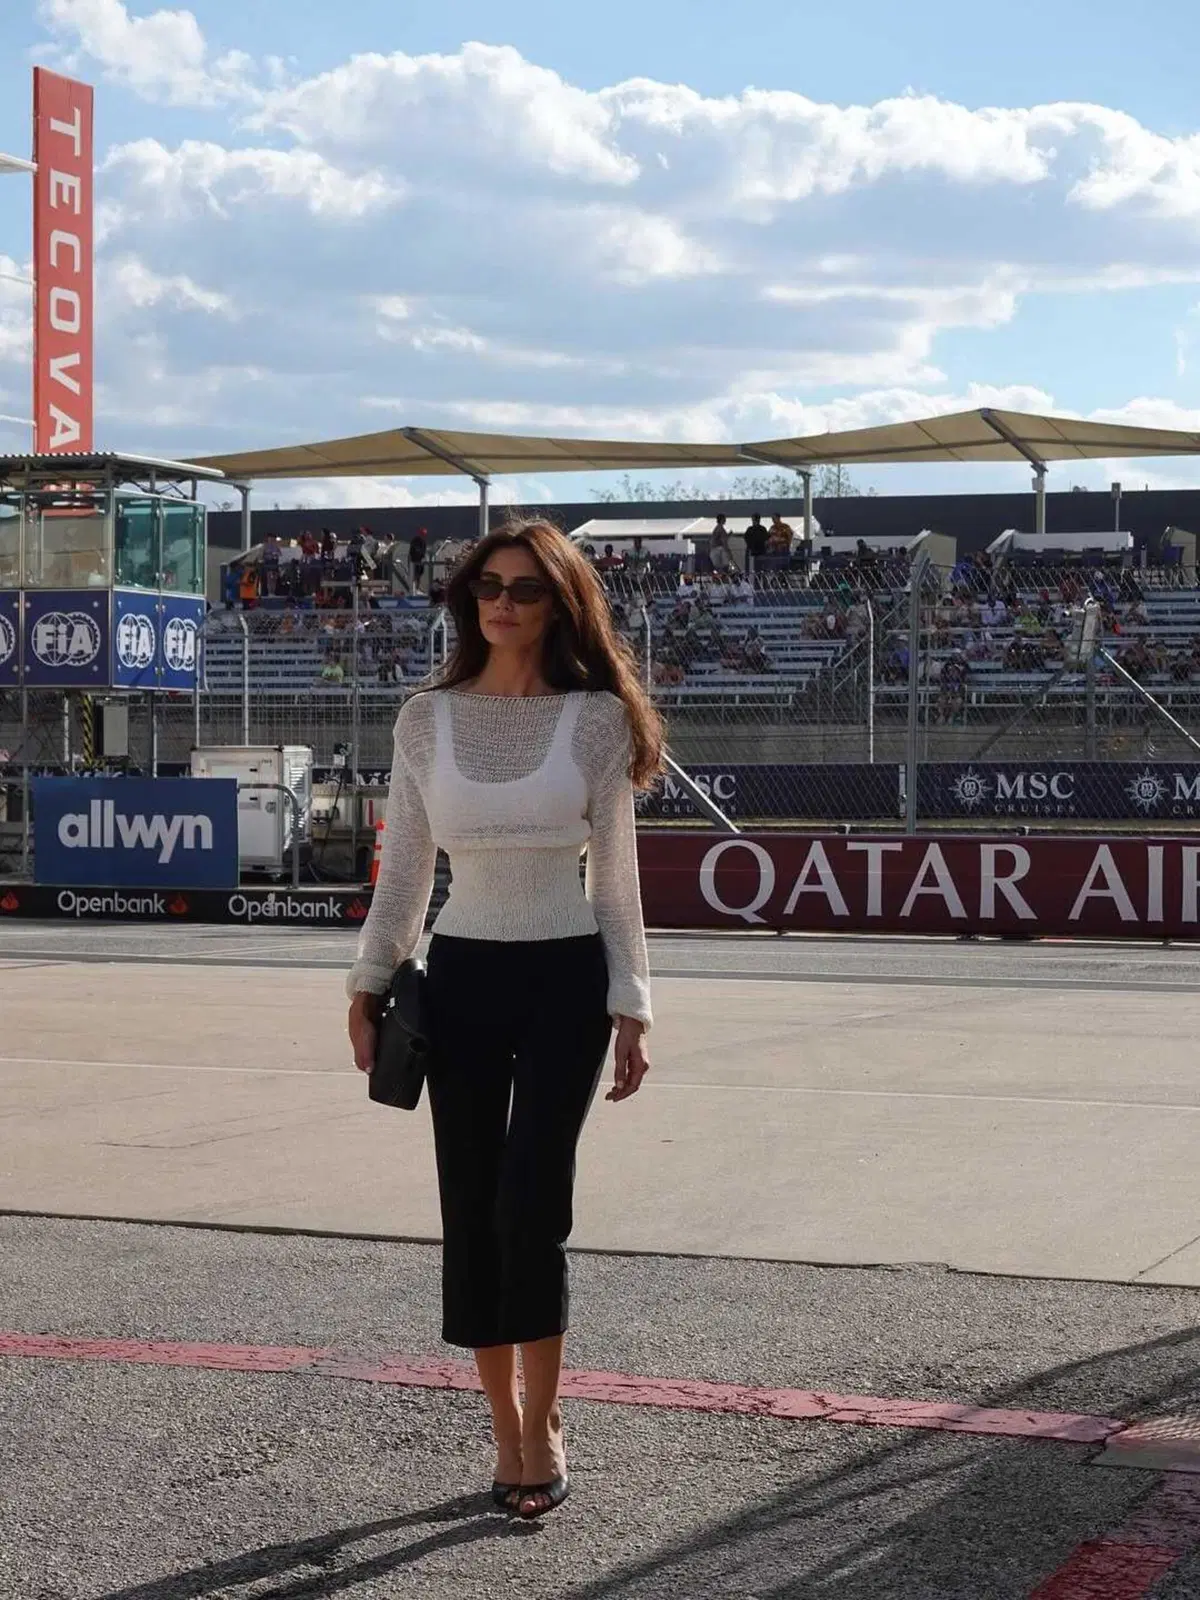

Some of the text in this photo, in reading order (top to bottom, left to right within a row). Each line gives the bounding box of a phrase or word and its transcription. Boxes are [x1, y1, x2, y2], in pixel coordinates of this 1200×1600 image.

[994, 771, 1075, 799] MSC
[994, 804, 1076, 813] CRUISES
[57, 799, 213, 864] allwyn
[699, 839, 1038, 923] QATAR
[57, 890, 166, 917] Openbank
[228, 893, 342, 921] Openbank
